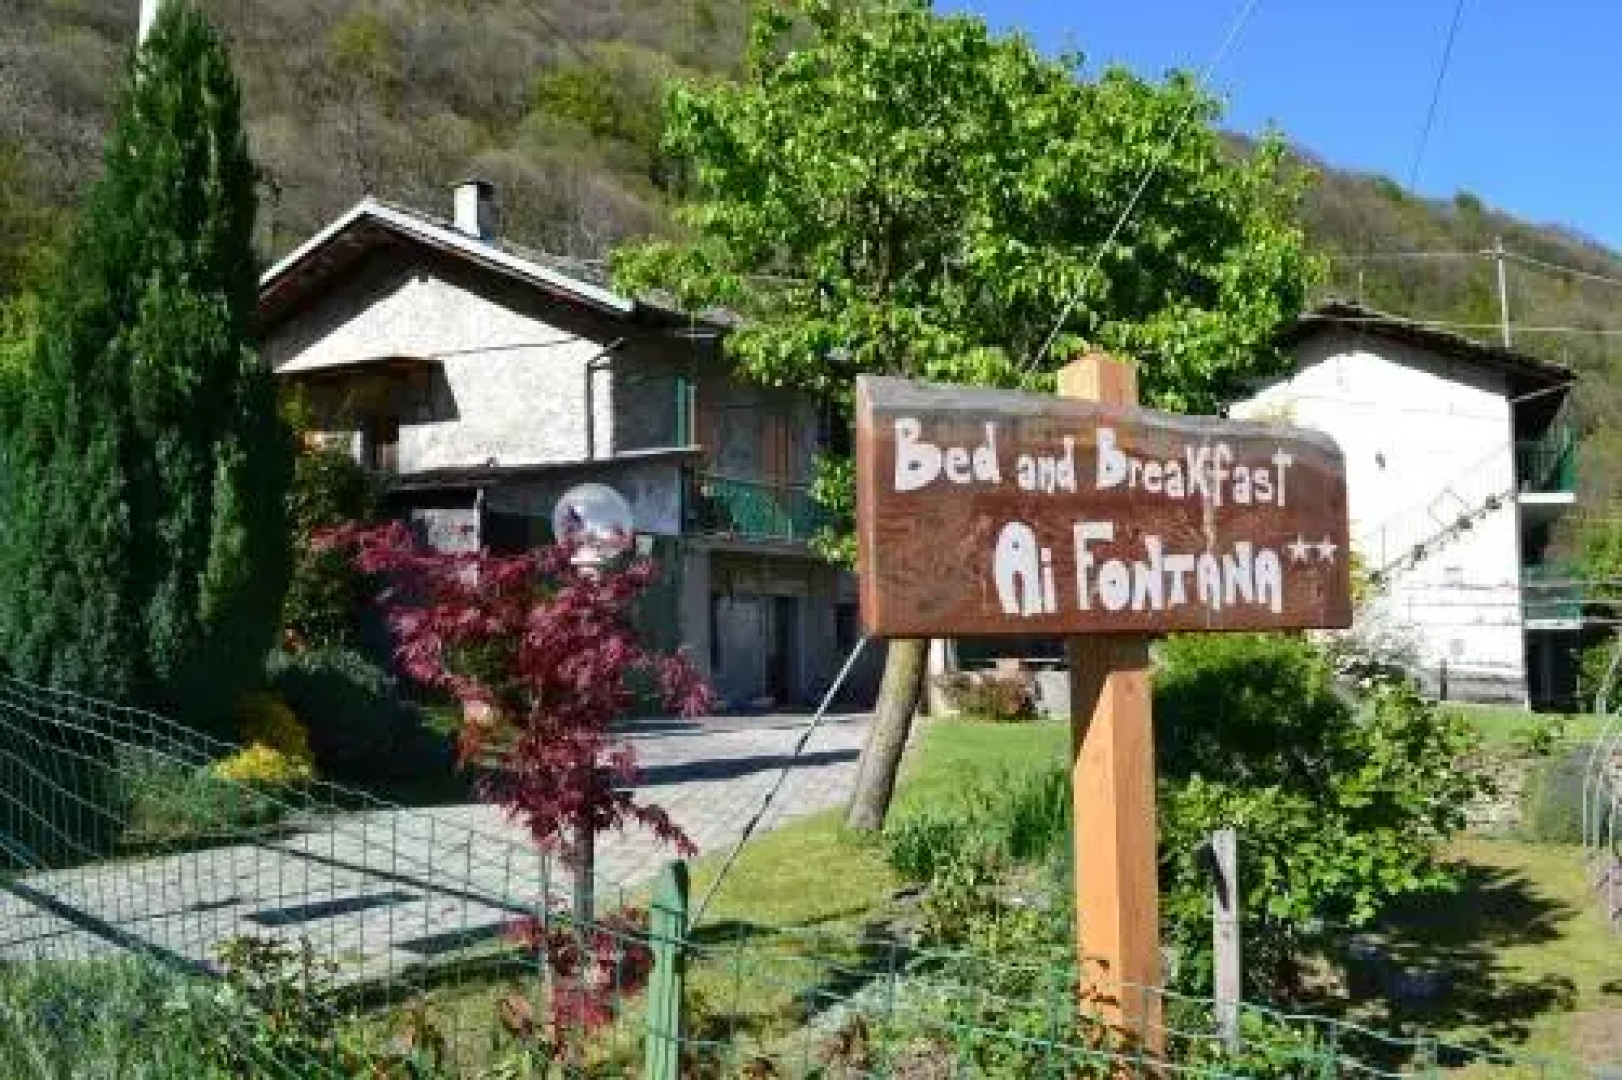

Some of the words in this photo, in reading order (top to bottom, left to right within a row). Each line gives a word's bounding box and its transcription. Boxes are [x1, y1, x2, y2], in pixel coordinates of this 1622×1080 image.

[894, 417, 1001, 491] Bed
[1016, 436, 1077, 494] and
[992, 521, 1058, 617] Ai
